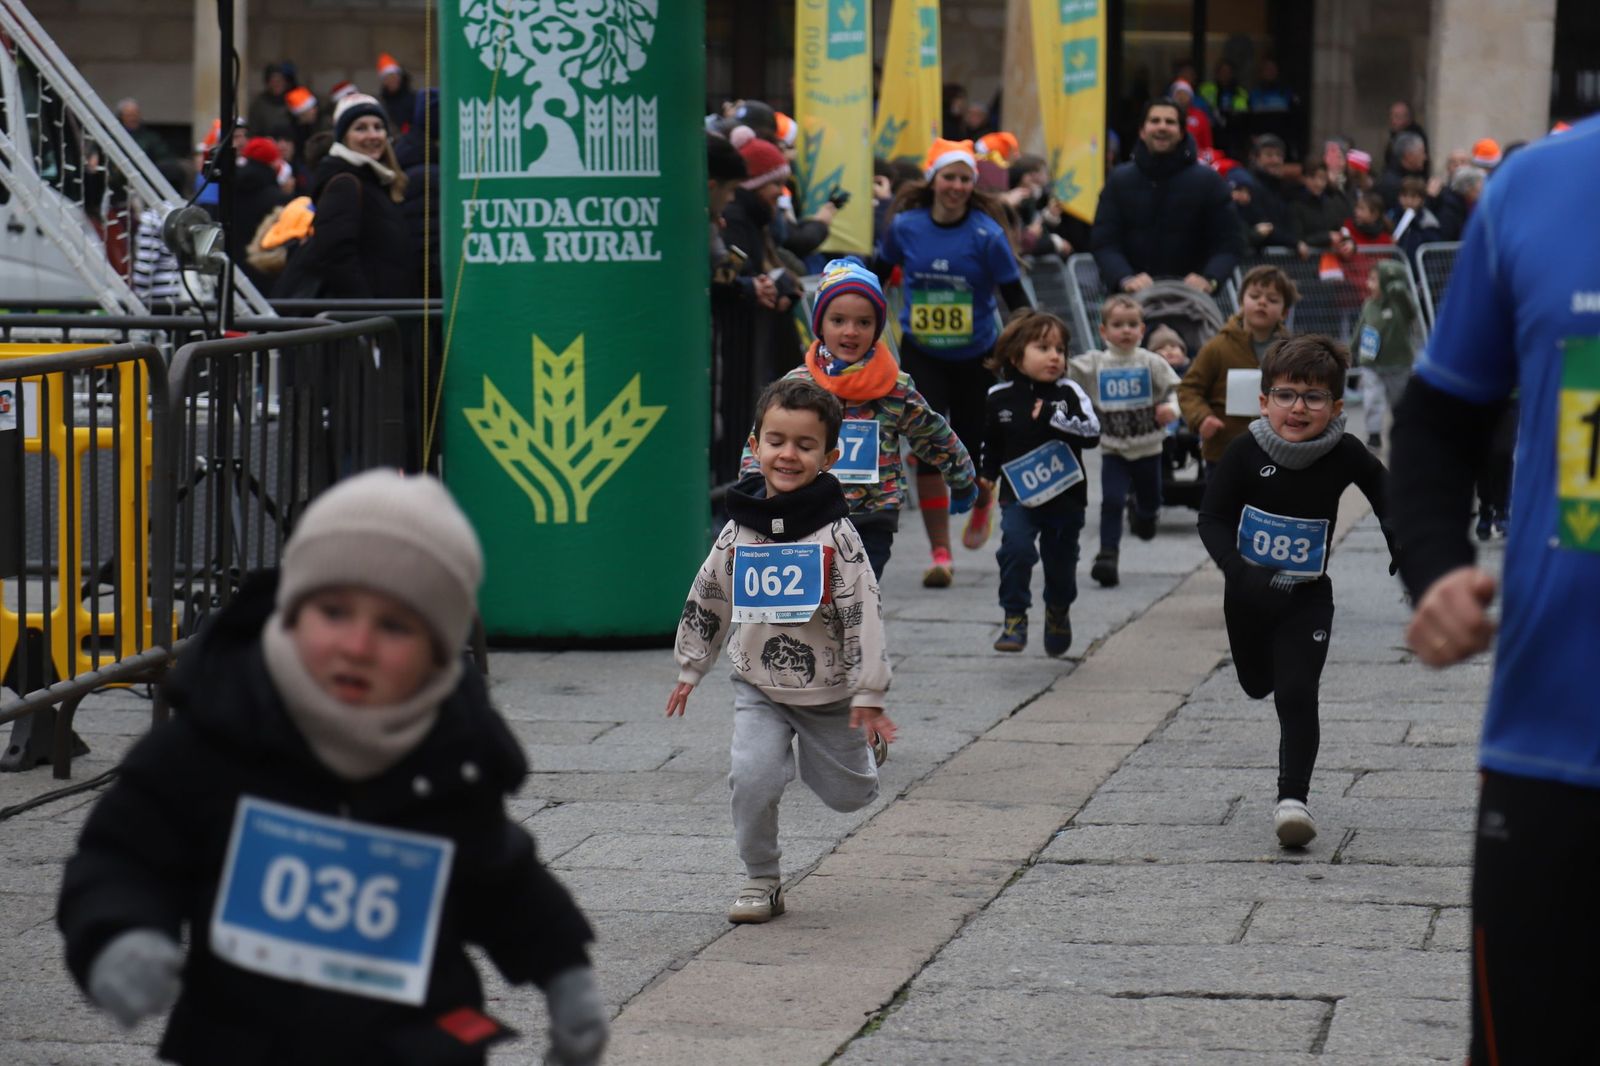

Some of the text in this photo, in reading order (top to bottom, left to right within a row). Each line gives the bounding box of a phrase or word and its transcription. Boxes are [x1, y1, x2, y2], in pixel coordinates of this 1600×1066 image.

[462, 196, 661, 228] FUNDACION
[463, 230, 661, 265] CAJA RURAL
[915, 307, 963, 331] 398
[1106, 377, 1142, 398] 085
[1021, 454, 1065, 491] 064
[1253, 530, 1311, 564] 083
[744, 565, 805, 597] 062
[260, 854, 400, 940] 036
